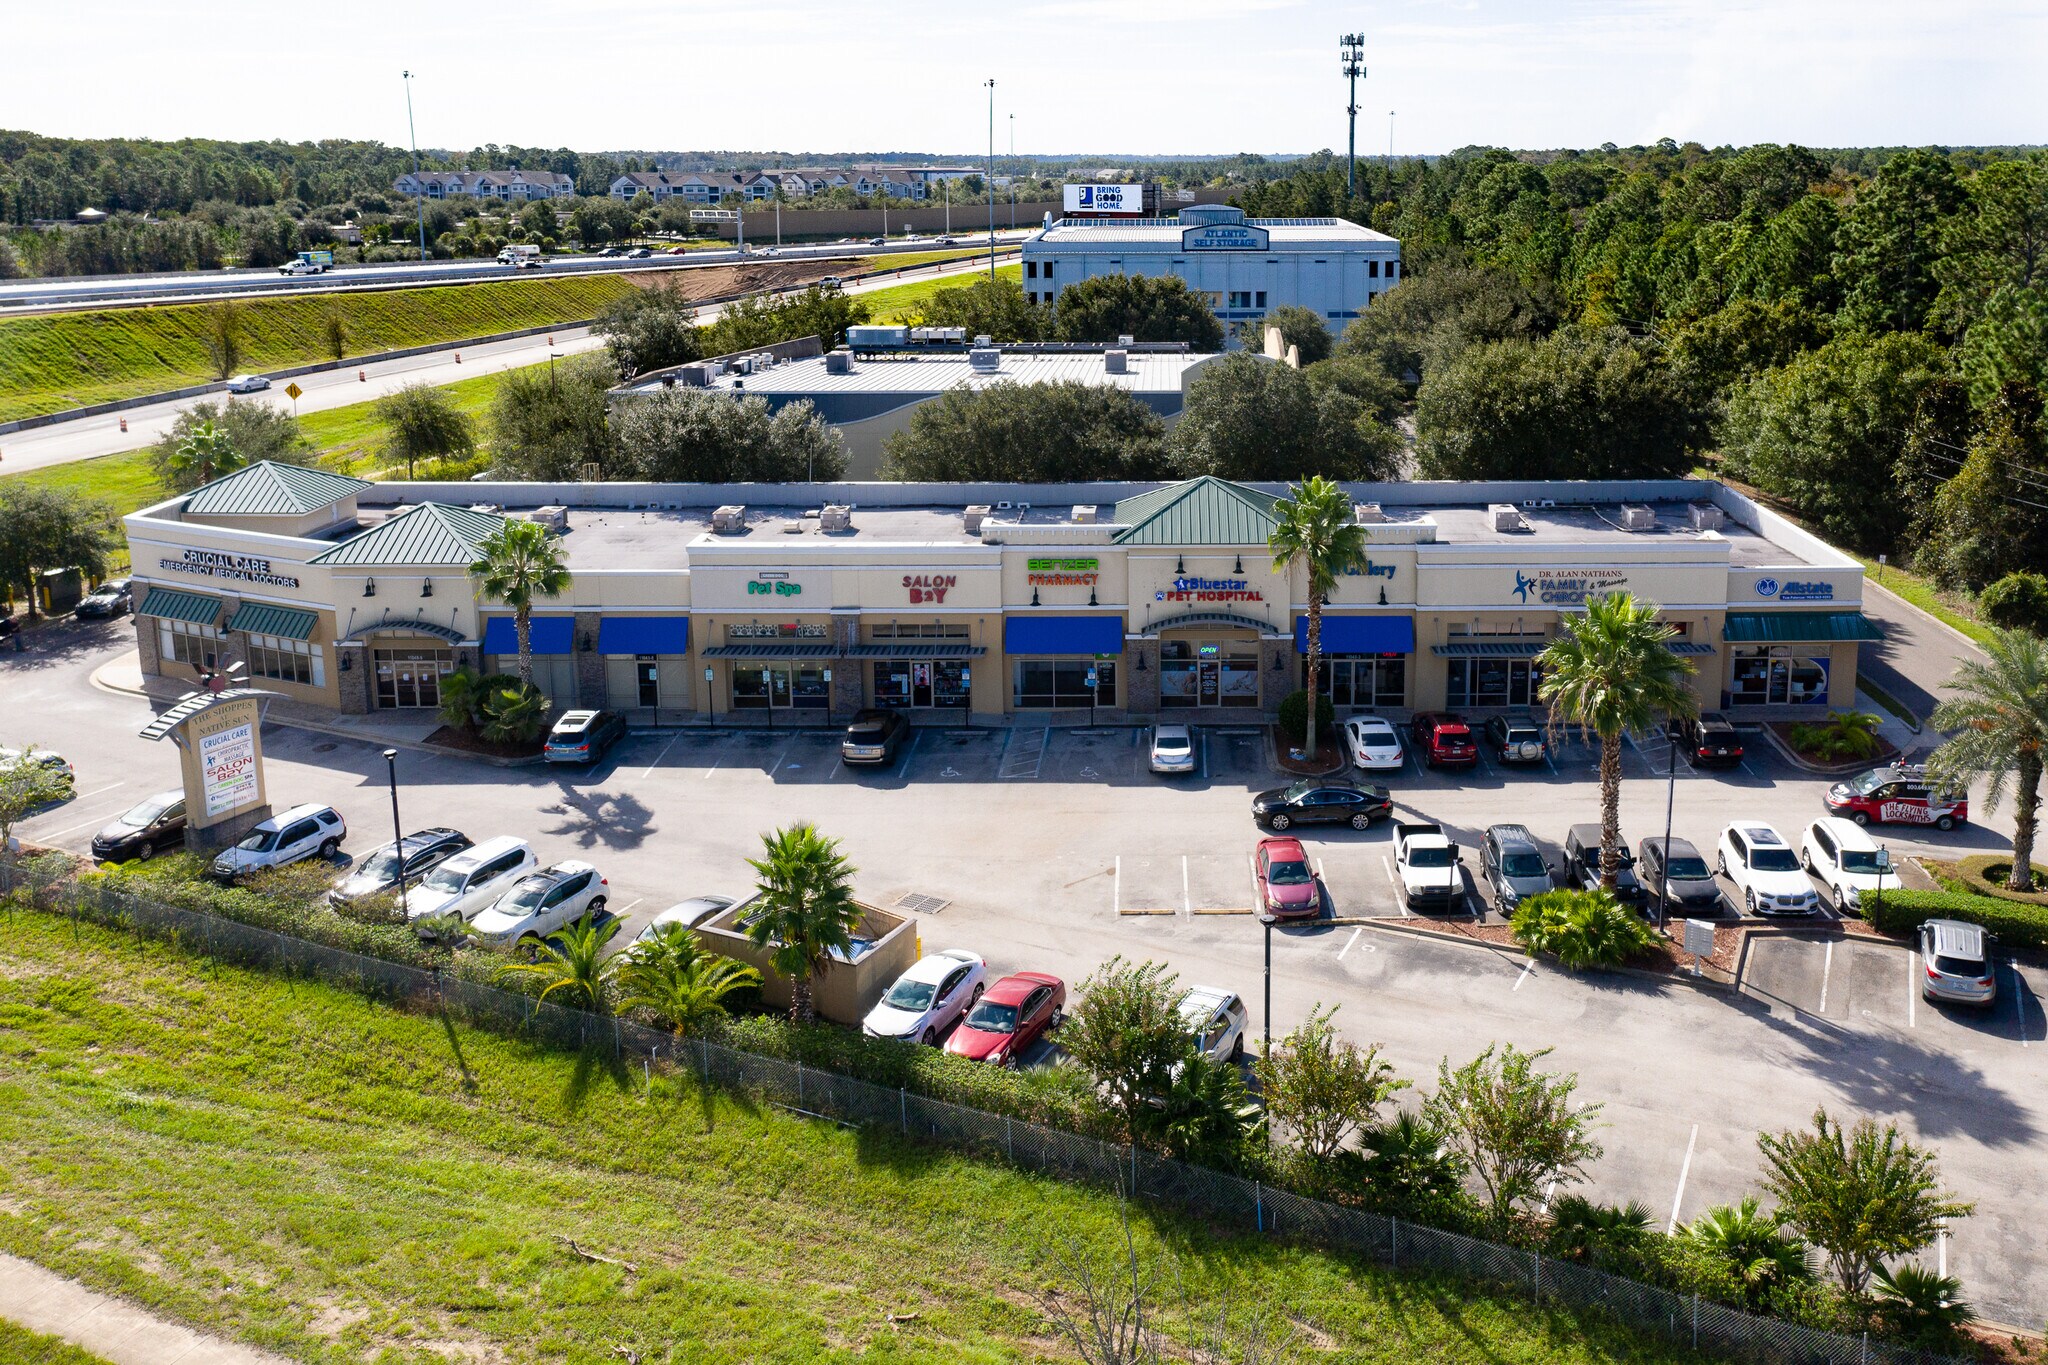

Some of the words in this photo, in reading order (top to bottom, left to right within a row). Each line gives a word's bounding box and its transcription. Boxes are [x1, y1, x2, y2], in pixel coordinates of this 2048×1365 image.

[1096, 186, 1121, 194] BRING
[1096, 194, 1123, 202] GOOD
[1204, 230, 1248, 238] ATLANTIC
[1193, 239, 1215, 247] SELF
[1216, 239, 1258, 247] STORAGE
[182, 550, 233, 569] CRUCIAL
[235, 557, 270, 573] CARE
[1027, 558, 1099, 571] BENZER
[159, 560, 211, 576] EMERGENCY
[212, 567, 252, 582] MEDICAL
[252, 574, 298, 589] DOCTORS
[1028, 573, 1099, 586] PHARMACY
[1539, 570, 1554, 578] DR.
[1556, 570, 1579, 578] ALAN
[1580, 570, 1623, 578] NATHANS
[902, 575, 956, 588] SALON
[1189, 577, 1248, 590] Bluestar
[1541, 579, 1587, 591] FAMILY
[1597, 577, 1628, 588] Massage
[1780, 581, 1833, 594] Allstate
[748, 581, 772, 595] Pet
[775, 581, 802, 597] Spa
[909, 587, 948, 604] B2Y
[1166, 591, 1192, 601] PET
[1197, 591, 1264, 601] HOSPITAL
[192, 711, 211, 725] THE
[213, 701, 253, 716] SHOPPES
[199, 719, 231, 735] NATIVE
[232, 713, 250, 726] SUN
[203, 734, 231, 749] CRUCIAL
[231, 728, 249, 740] CARE
[207, 756, 253, 778] SALON
[217, 766, 244, 782] B2Y
[1884, 803, 1899, 812] THE
[1900, 803, 1928, 815] FLYING
[1885, 811, 1931, 823] LOCKSMITHS
